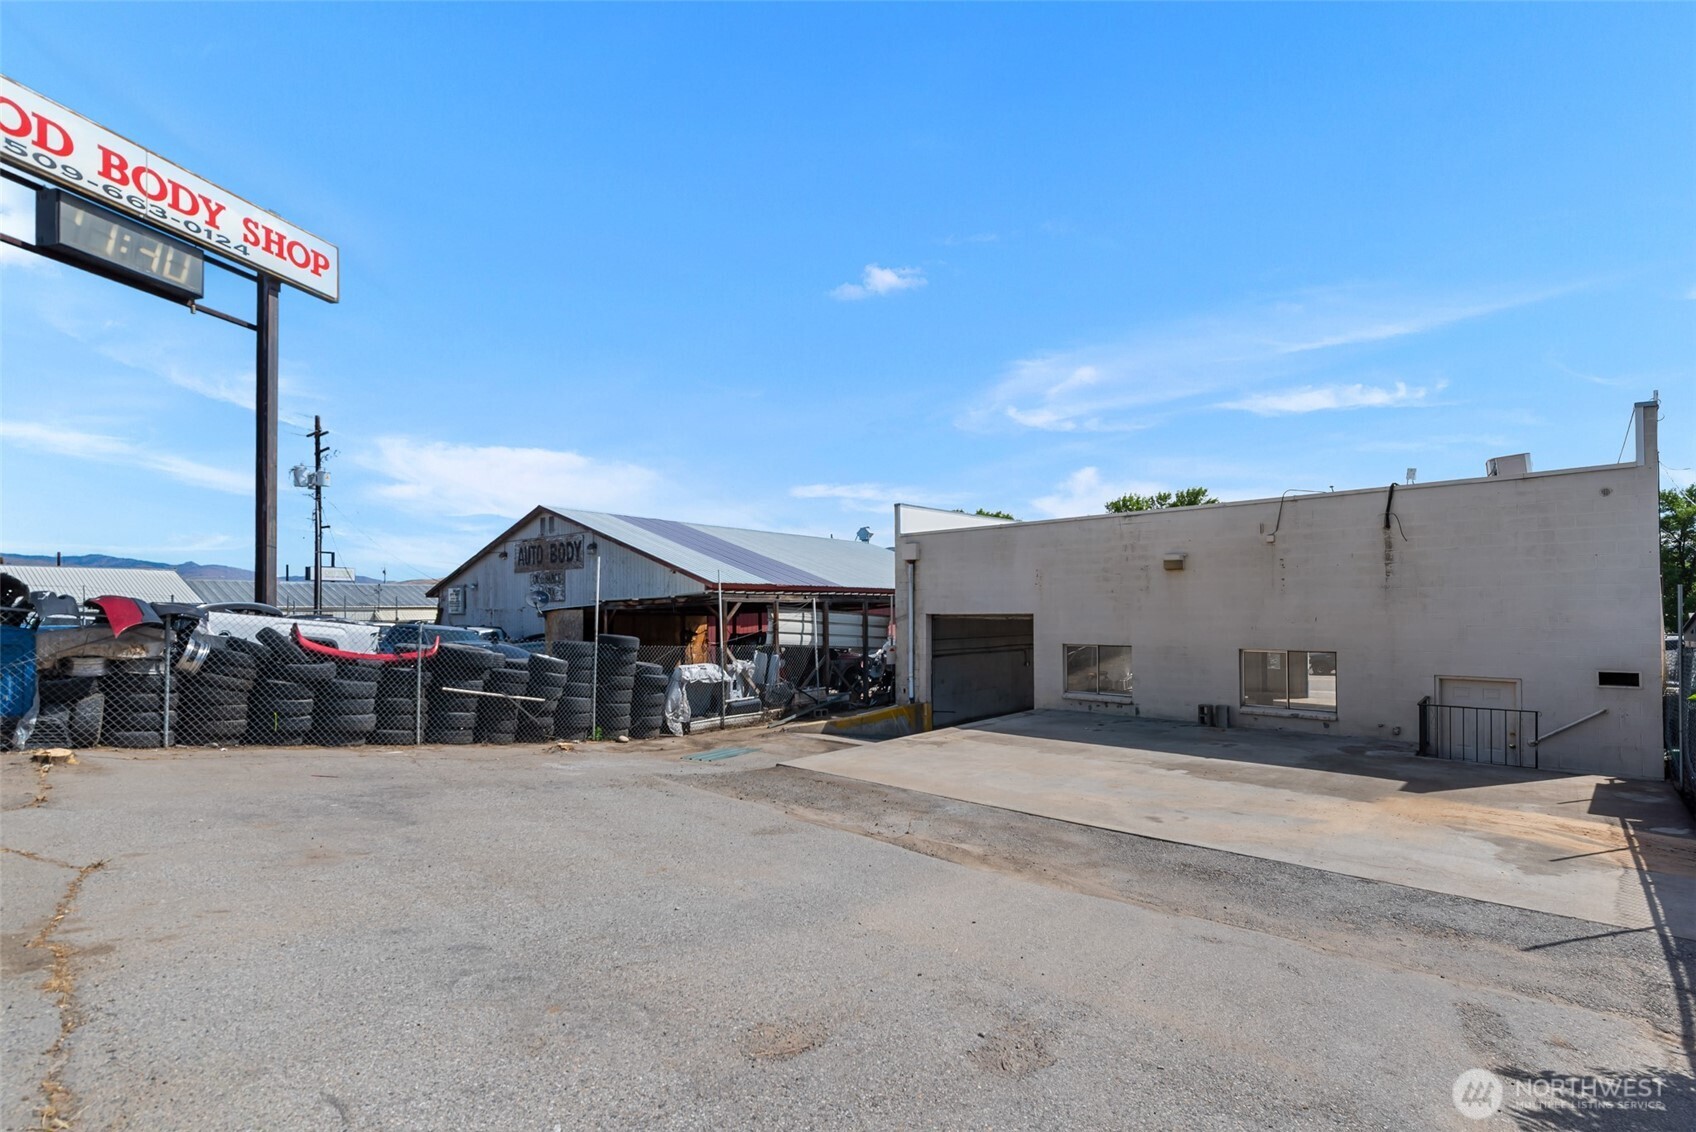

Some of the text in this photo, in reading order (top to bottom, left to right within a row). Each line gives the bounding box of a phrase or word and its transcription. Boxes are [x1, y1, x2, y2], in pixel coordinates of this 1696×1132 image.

[3, 137, 250, 256] 509-663-0124
[97, 144, 226, 230] BODY
[242, 217, 330, 277] SHOP
[518, 540, 582, 566] AUTO BODY
